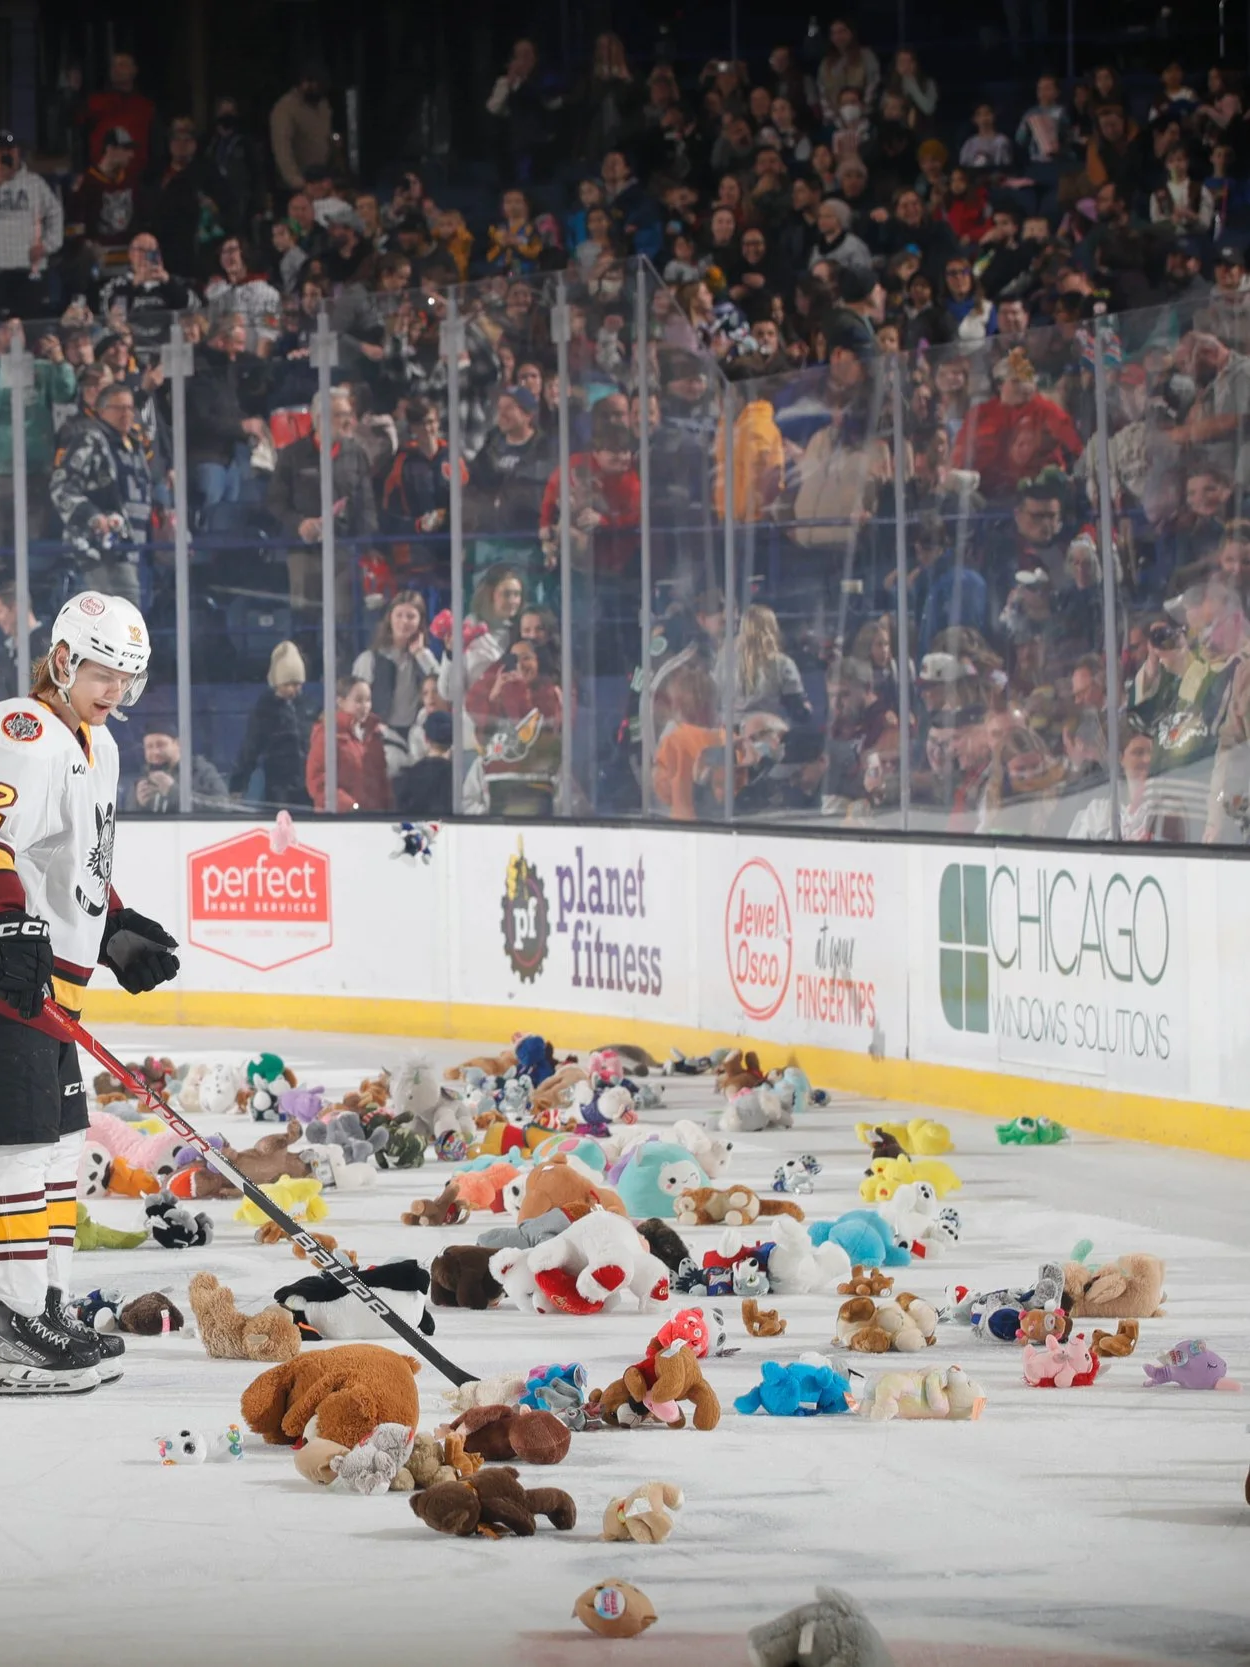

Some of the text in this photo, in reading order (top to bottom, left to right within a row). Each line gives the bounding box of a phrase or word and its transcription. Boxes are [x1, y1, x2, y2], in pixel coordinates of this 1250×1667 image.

[200, 852, 317, 912] perfect
[210, 902, 317, 914] HOME SERVICES
[555, 846, 646, 933] planet
[795, 867, 875, 919] FRESHNESS
[512, 896, 538, 950] pf
[734, 887, 780, 940] Jewel
[988, 864, 1170, 986] CHICAGO
[571, 918, 662, 997] fitness
[736, 939, 779, 988] Osco
[796, 973, 876, 1029] FINGERTIPS
[990, 993, 1170, 1060] WINDOWS SOLUTIONS
